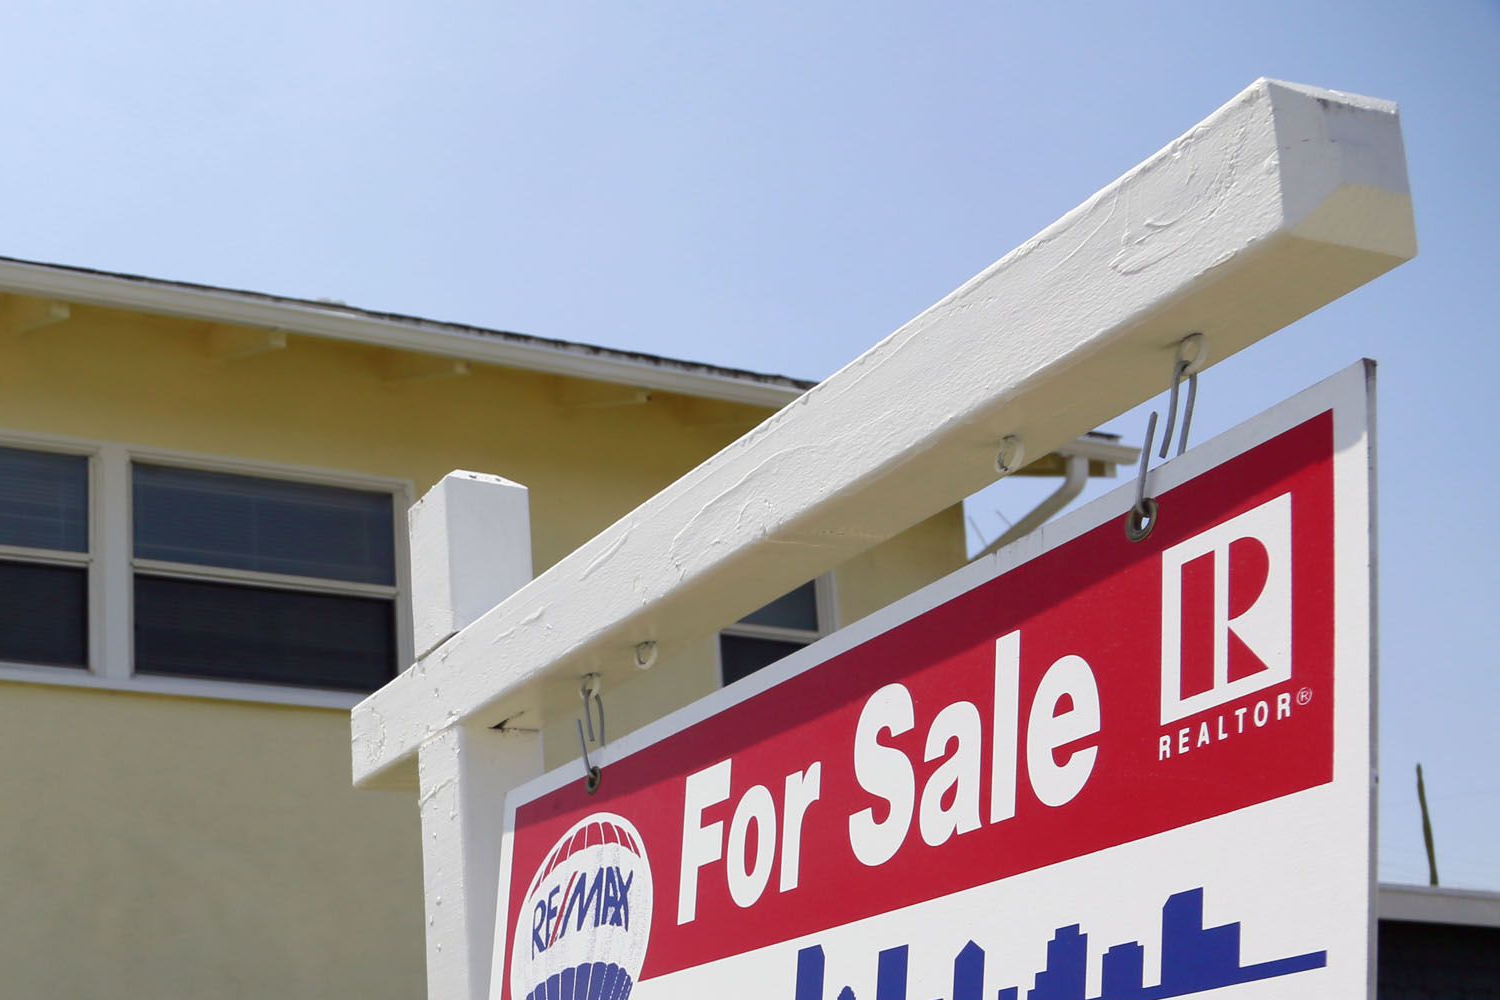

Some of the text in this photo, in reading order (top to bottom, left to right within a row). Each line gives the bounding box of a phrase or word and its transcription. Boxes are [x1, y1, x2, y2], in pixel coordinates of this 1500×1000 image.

[677, 631, 1102, 925] For Sale
[532, 866, 634, 961] RE/MAX
